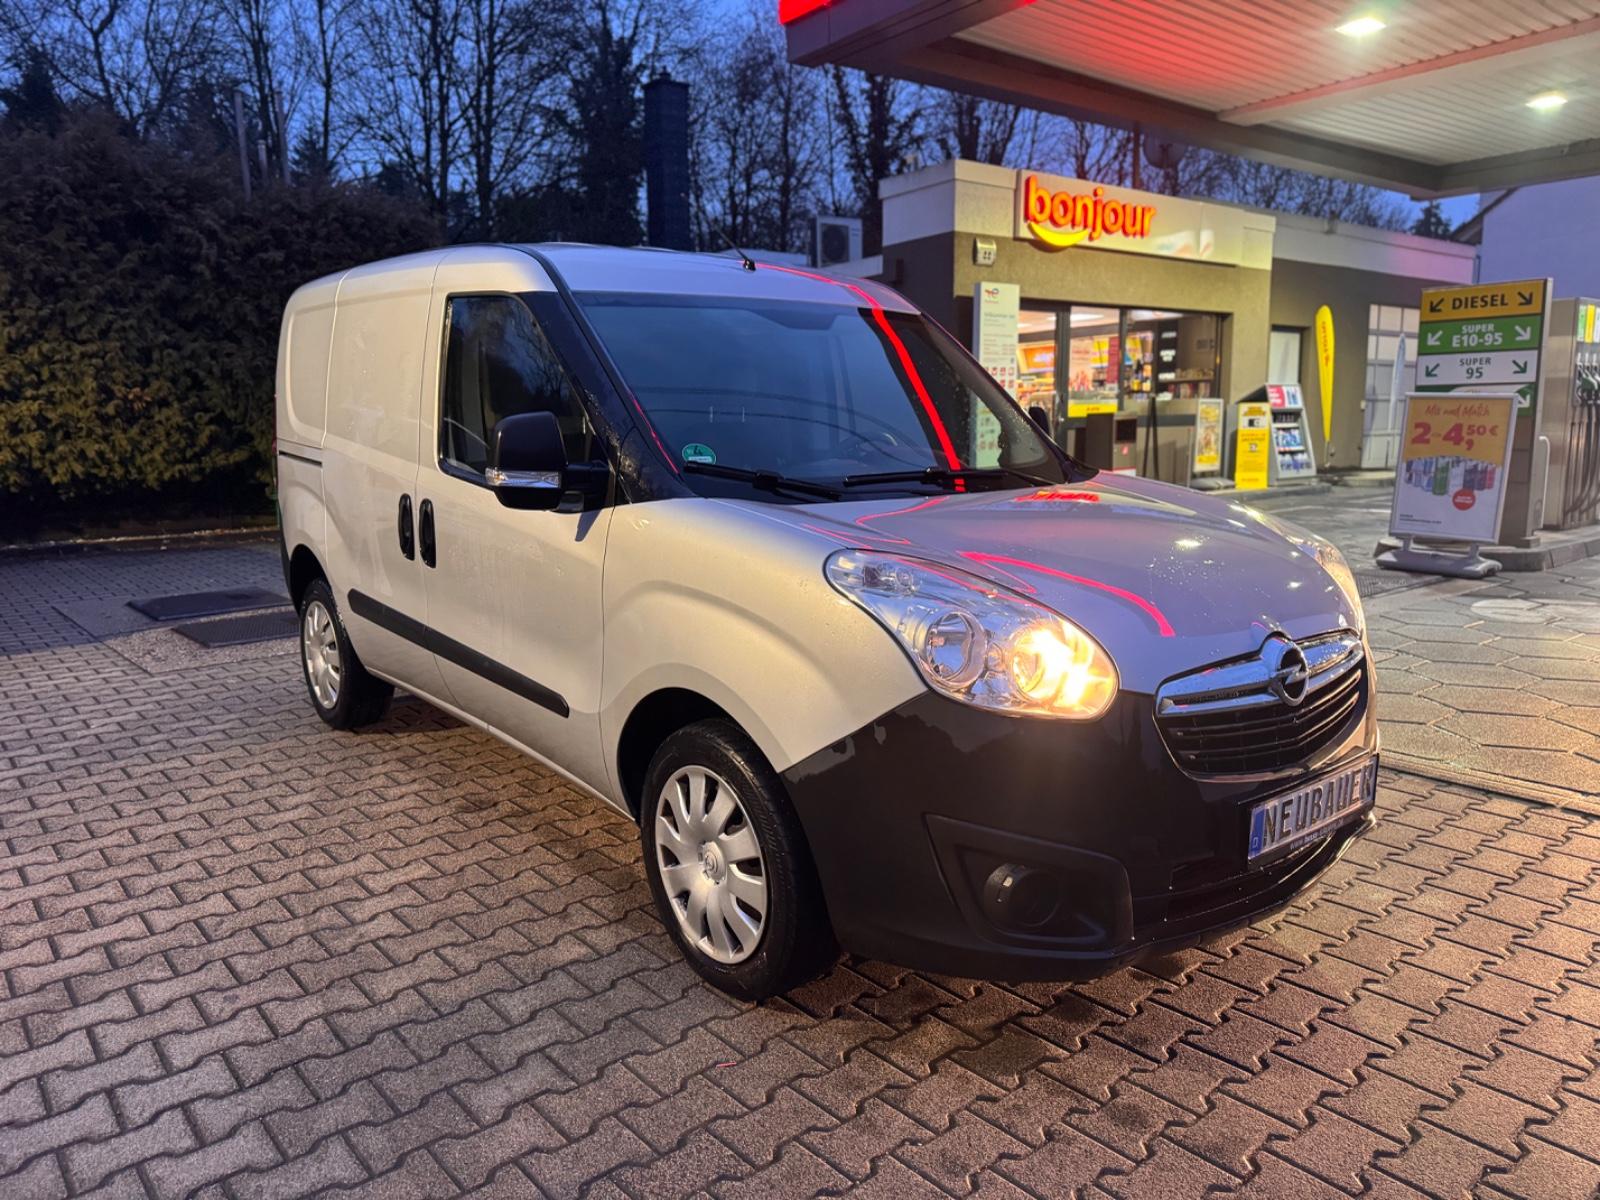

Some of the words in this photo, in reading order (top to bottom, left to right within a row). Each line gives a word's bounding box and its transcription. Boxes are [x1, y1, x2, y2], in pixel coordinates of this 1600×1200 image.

[1025, 174, 1156, 242] bonjour
[1452, 293, 1508, 310] DIESEL
[1461, 323, 1495, 334] SUPER
[1452, 332, 1503, 348] E10-95
[1459, 357, 1491, 366] SUPER
[1466, 367, 1483, 379] 95
[1411, 422, 1431, 444] 2
[1263, 763, 1374, 848] NEUBAUER
